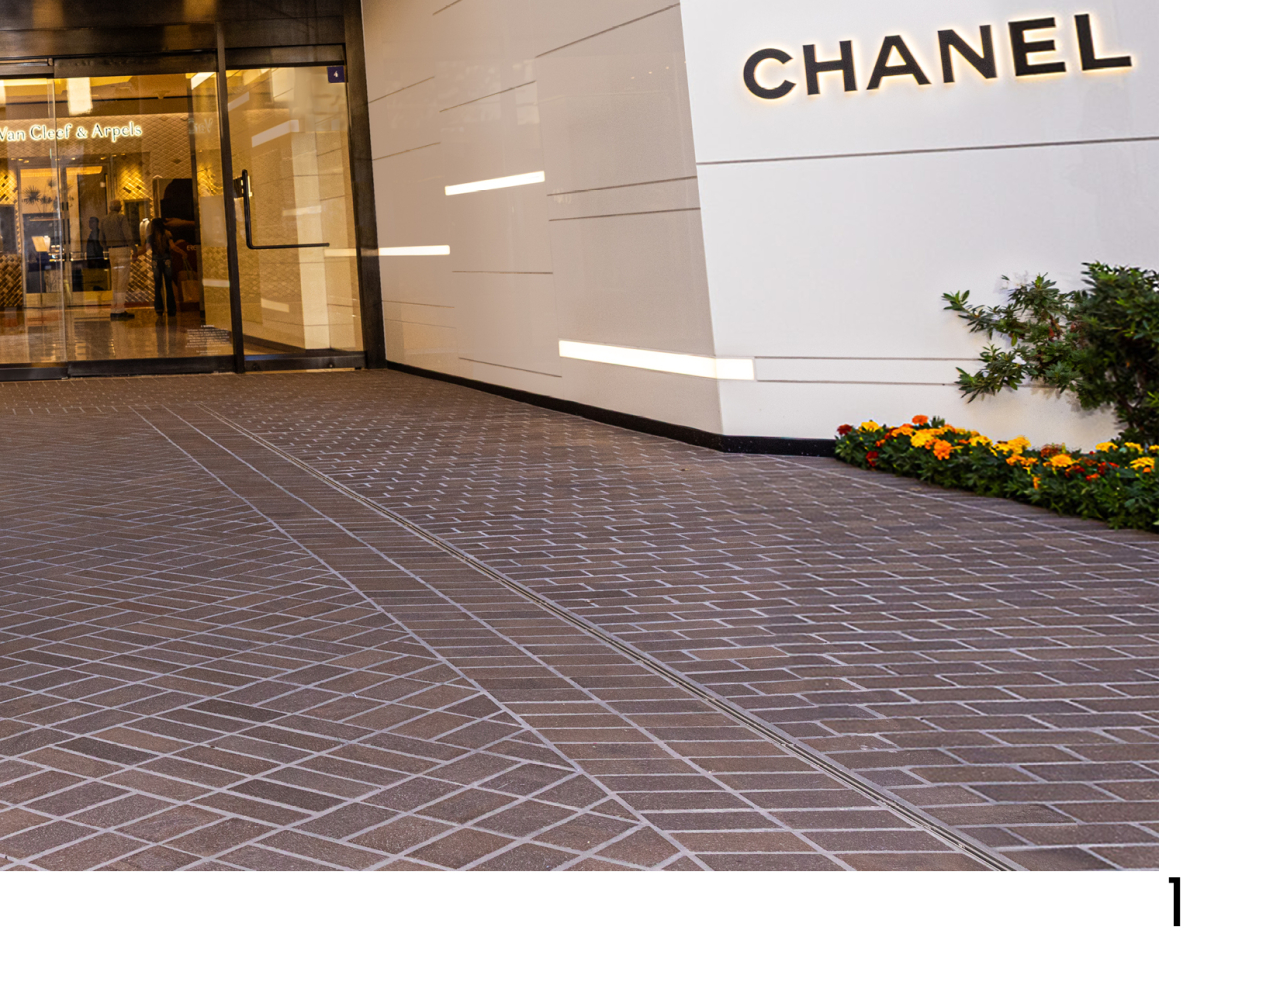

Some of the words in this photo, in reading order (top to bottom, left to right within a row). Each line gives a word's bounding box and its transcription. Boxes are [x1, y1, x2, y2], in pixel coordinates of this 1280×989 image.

[743, 13, 1132, 100] CHANEL
[29, 123, 72, 141] Cleef
[76, 126, 88, 139] &
[92, 120, 142, 143] Arpels
